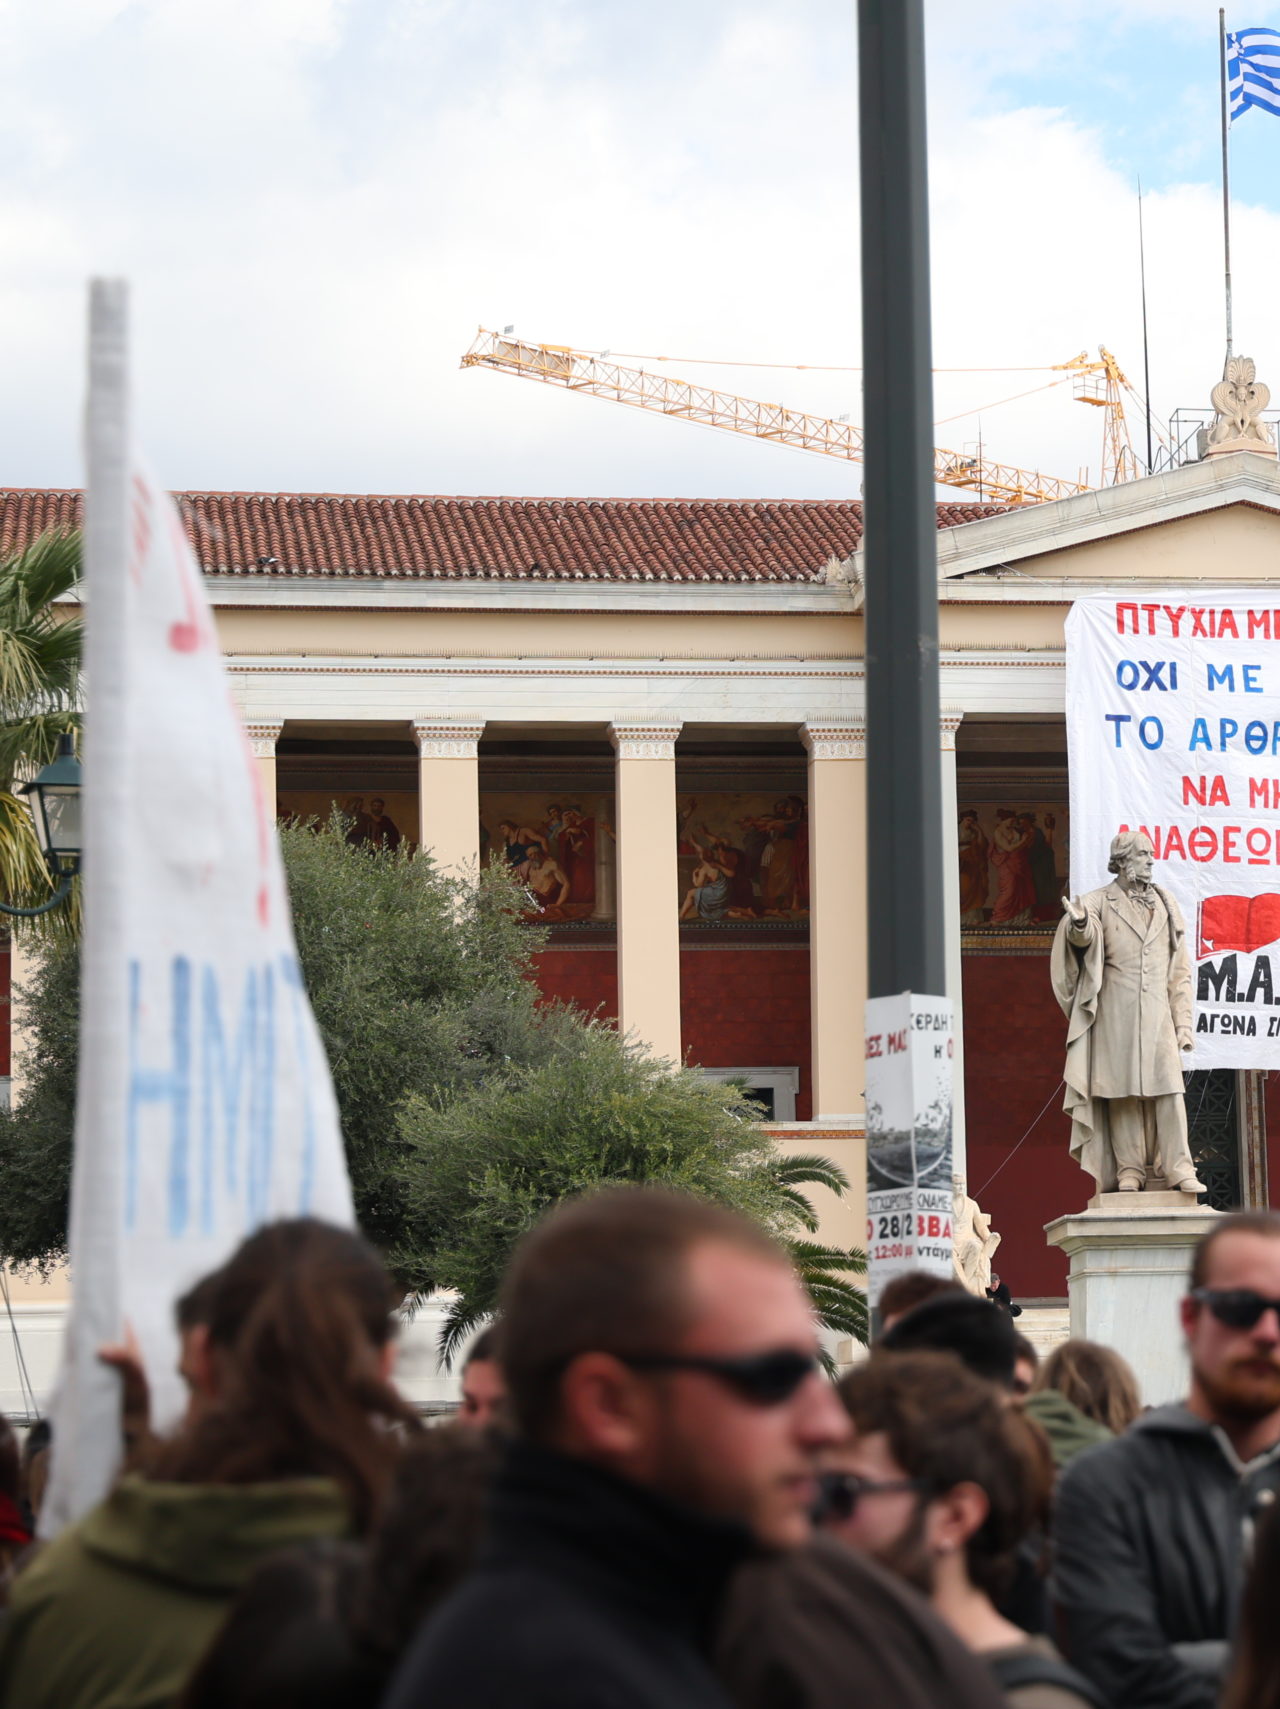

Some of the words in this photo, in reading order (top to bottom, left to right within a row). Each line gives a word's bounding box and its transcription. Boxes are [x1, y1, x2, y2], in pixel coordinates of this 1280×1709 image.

[1116, 602, 1240, 639] ΠΤΥΧΙΑ
[1116, 659, 1178, 691] ΟΧΙ
[1207, 663, 1264, 693] ΜΕ
[1105, 714, 1164, 751] ΤΟ
[1182, 775, 1231, 807] ΝΑ
[1196, 1012, 1257, 1037] ΑΓΩΝΑ
[879, 1213, 912, 1240] 28/2
